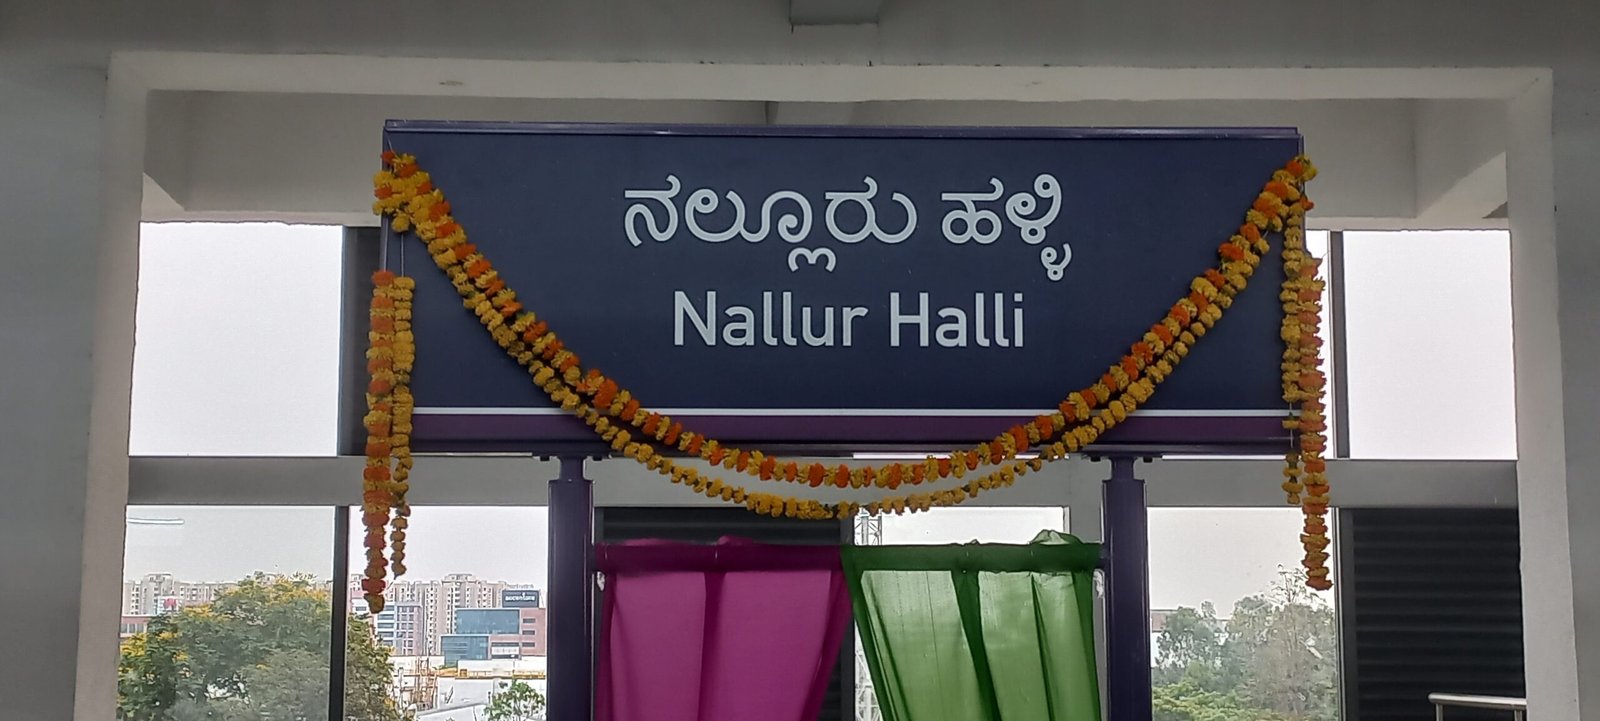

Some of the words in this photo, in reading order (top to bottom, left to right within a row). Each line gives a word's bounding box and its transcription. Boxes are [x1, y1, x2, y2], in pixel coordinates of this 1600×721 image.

[624, 174, 918, 272] ನಲ್ಲೂರು
[941, 173, 1072, 281] ಹಳ್ಳಿ
[673, 291, 869, 347] Nallur
[890, 292, 1024, 347] Halli
